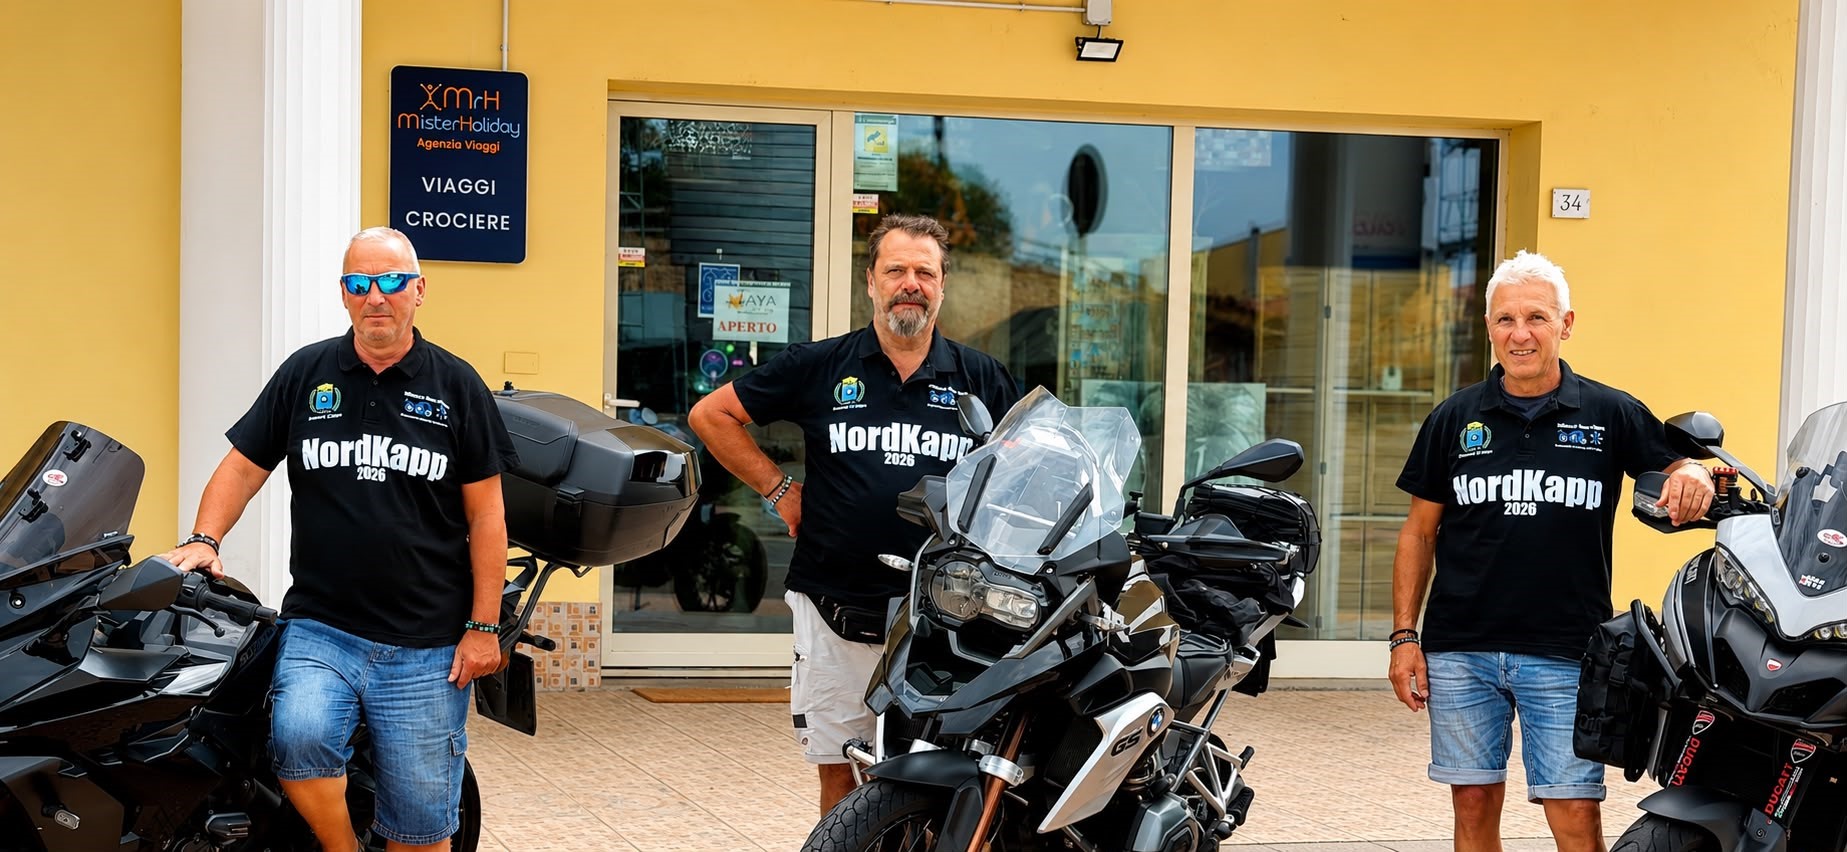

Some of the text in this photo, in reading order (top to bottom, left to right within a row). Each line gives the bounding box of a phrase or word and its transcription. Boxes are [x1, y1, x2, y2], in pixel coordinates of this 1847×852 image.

[417, 137, 501, 154] Agenzia Viaggi
[421, 176, 496, 195] VIAGGI
[1560, 194, 1581, 211] 34
[405, 210, 511, 231] CROCIERE
[718, 320, 777, 333] APERTO
[302, 433, 449, 482] NordKapp
[884, 452, 915, 467] 2026
[356, 465, 387, 482] 2026
[1453, 469, 1603, 511] NordKapp
[1503, 502, 1537, 516] 2026
[1110, 727, 1144, 757] GS
